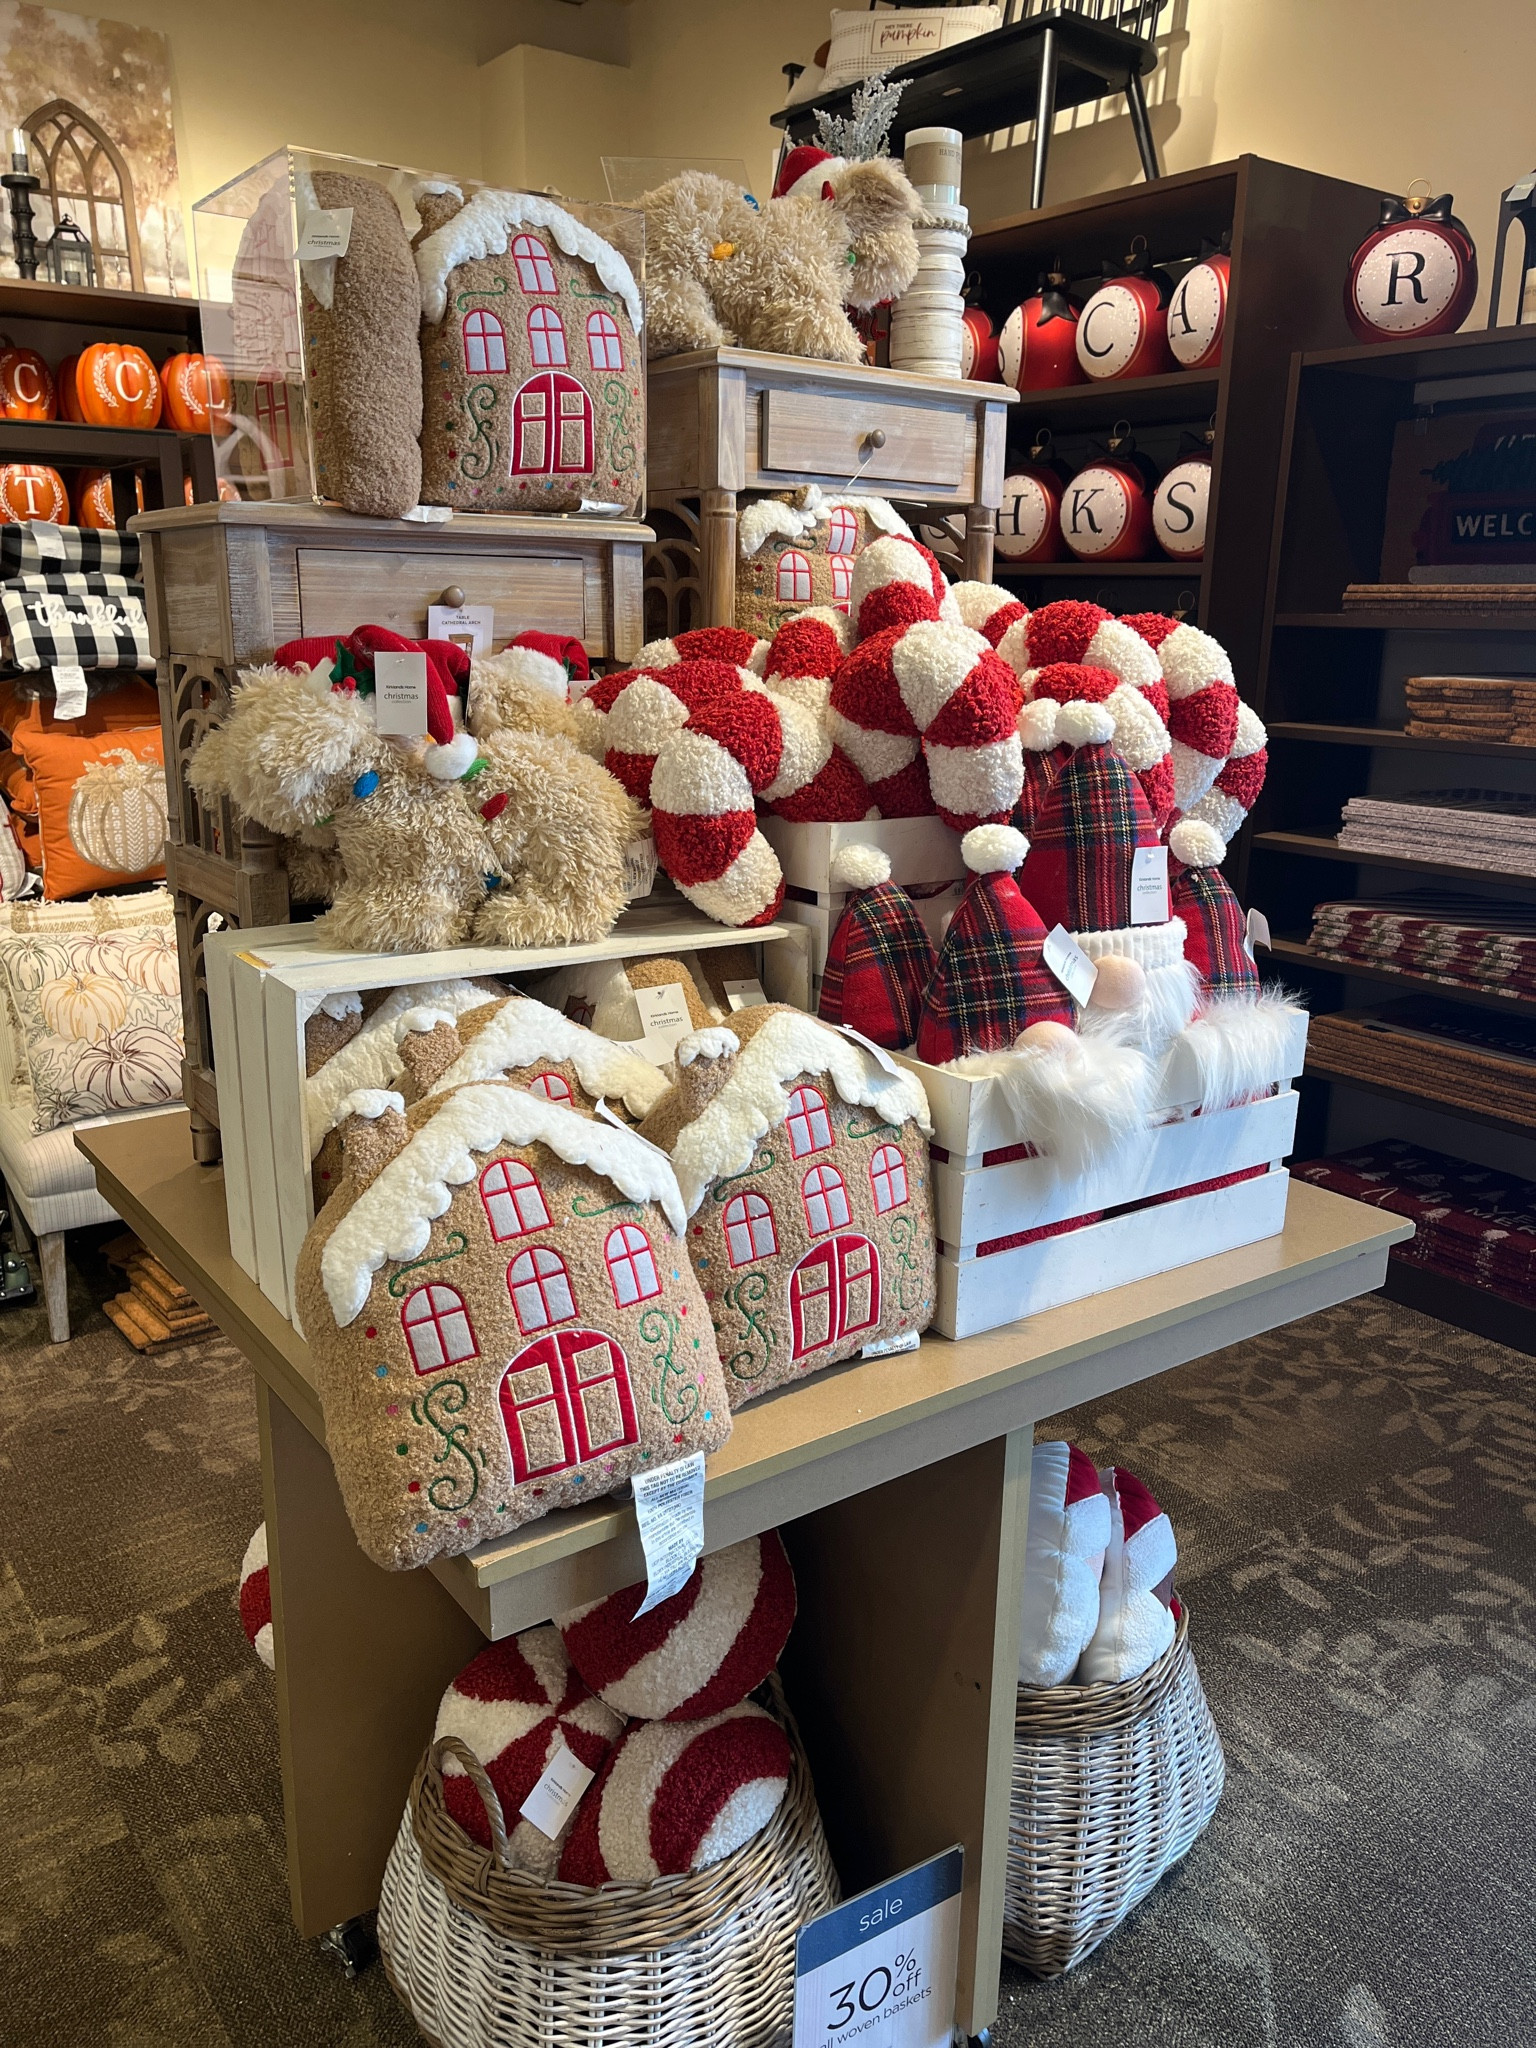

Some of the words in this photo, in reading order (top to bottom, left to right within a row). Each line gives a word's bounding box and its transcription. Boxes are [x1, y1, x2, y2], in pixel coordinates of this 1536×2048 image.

[880, 22, 937, 48] pumpkin
[1381, 251, 1428, 306] R
[1169, 279, 1197, 339] A
[1083, 301, 1115, 358] C
[14, 363, 41, 403] C
[115, 361, 143, 402] C
[14, 476, 44, 515] T
[1070, 488, 1105, 534] K
[1164, 481, 1197, 534] S
[27, 600, 148, 637] thankful
[383, 692, 419, 700] christmas
[1136, 884, 1163, 892] christmas
[650, 1017, 684, 1027] christmas
[645, 1475, 660, 1484] UNDER
[858, 1898, 903, 1933] sale
[892, 1968, 922, 1998] off
[837, 2014, 880, 2045] woven
[884, 1986, 932, 2020] baskets
